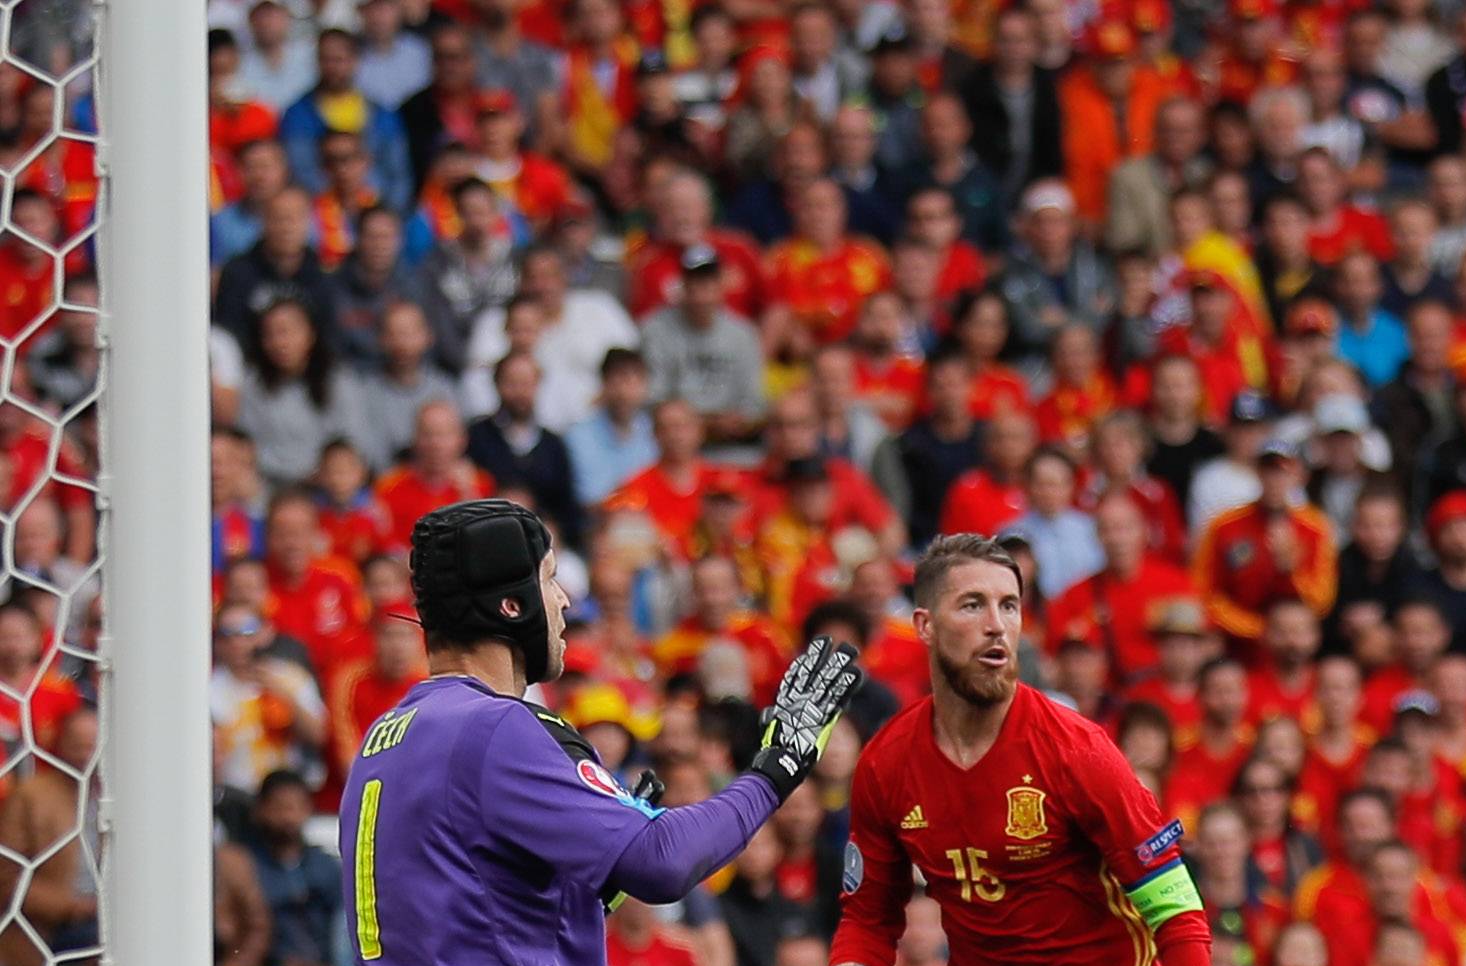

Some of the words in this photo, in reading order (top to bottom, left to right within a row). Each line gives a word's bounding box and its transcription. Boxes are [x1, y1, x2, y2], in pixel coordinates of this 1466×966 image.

[1149, 822, 1184, 853] RESPECT
[355, 778, 383, 961] 1
[945, 847, 1006, 902] 15
